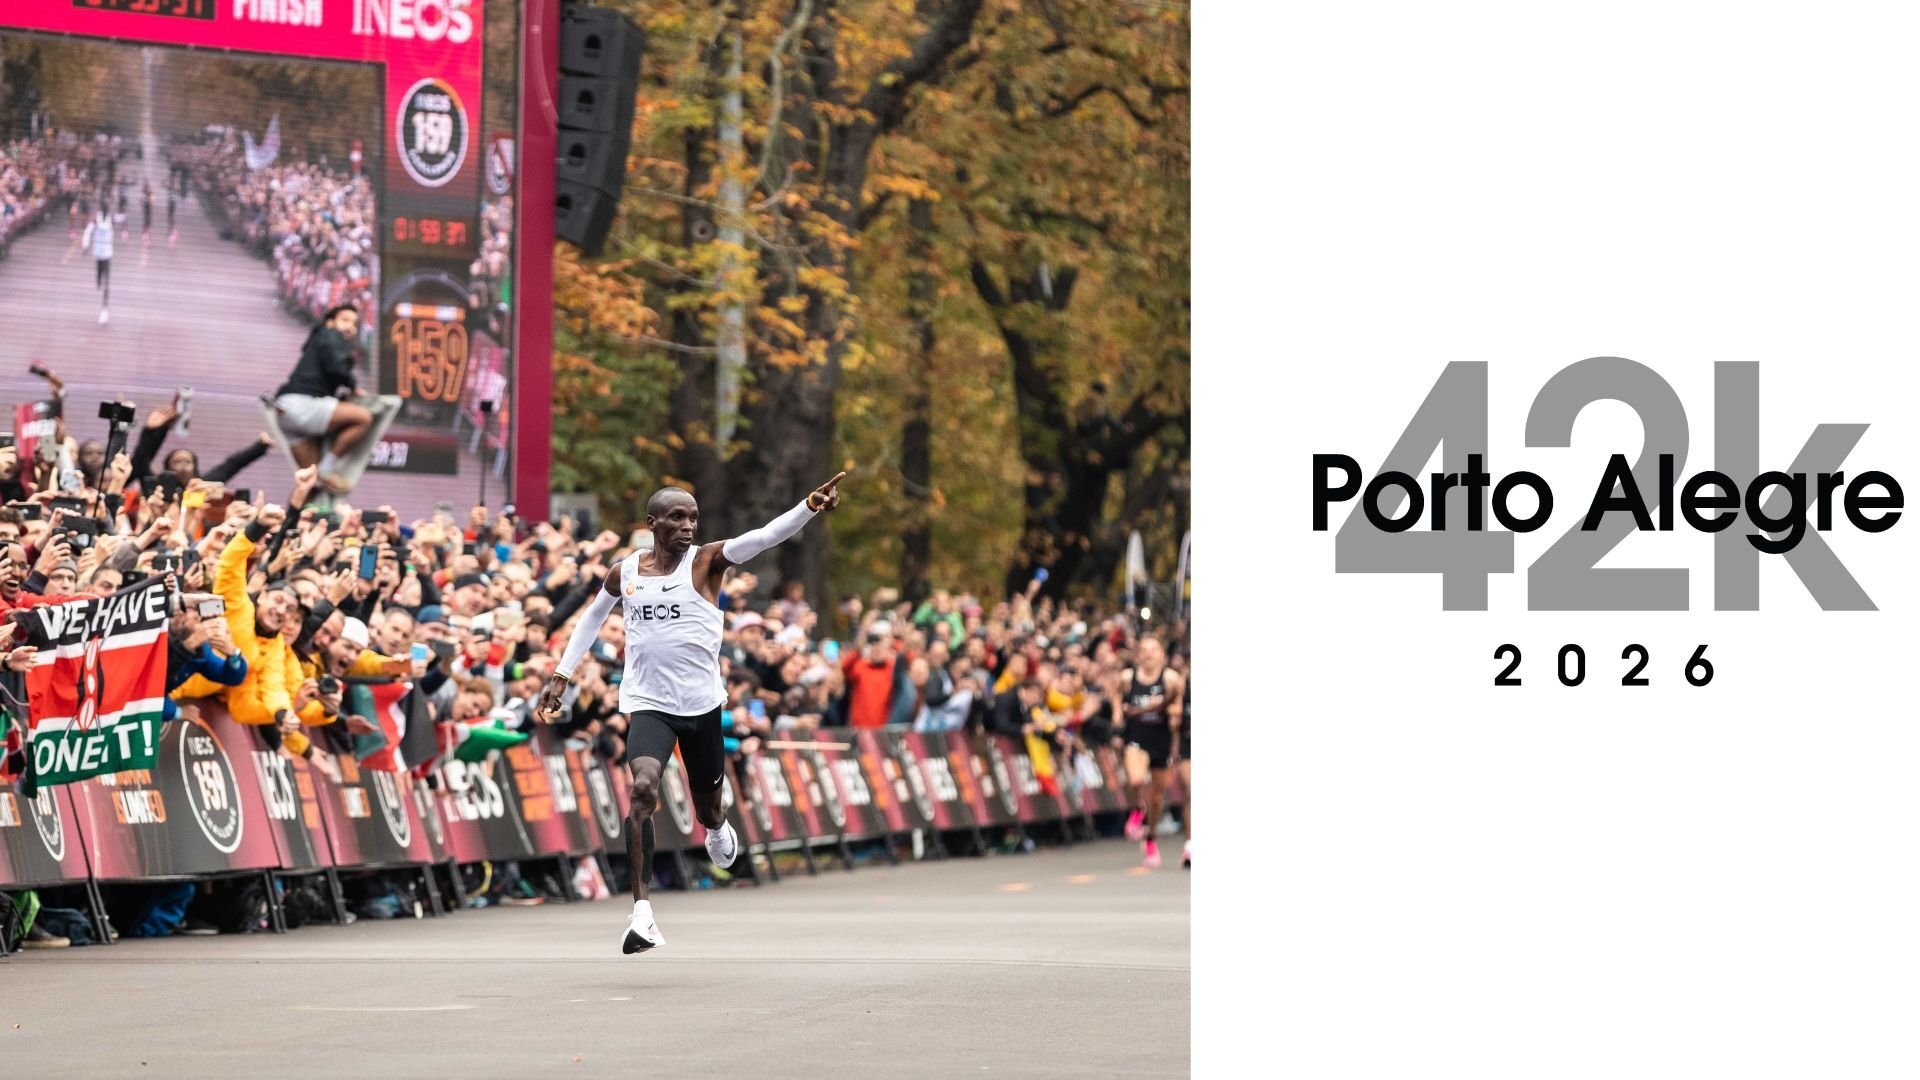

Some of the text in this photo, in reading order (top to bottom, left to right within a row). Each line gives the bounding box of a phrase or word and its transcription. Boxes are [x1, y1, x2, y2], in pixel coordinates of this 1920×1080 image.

[232, 0, 323, 27] FINISH
[351, 0, 473, 43] INEOS
[37, 583, 167, 641] WE HAVE
[33, 735, 105, 776] ONE
